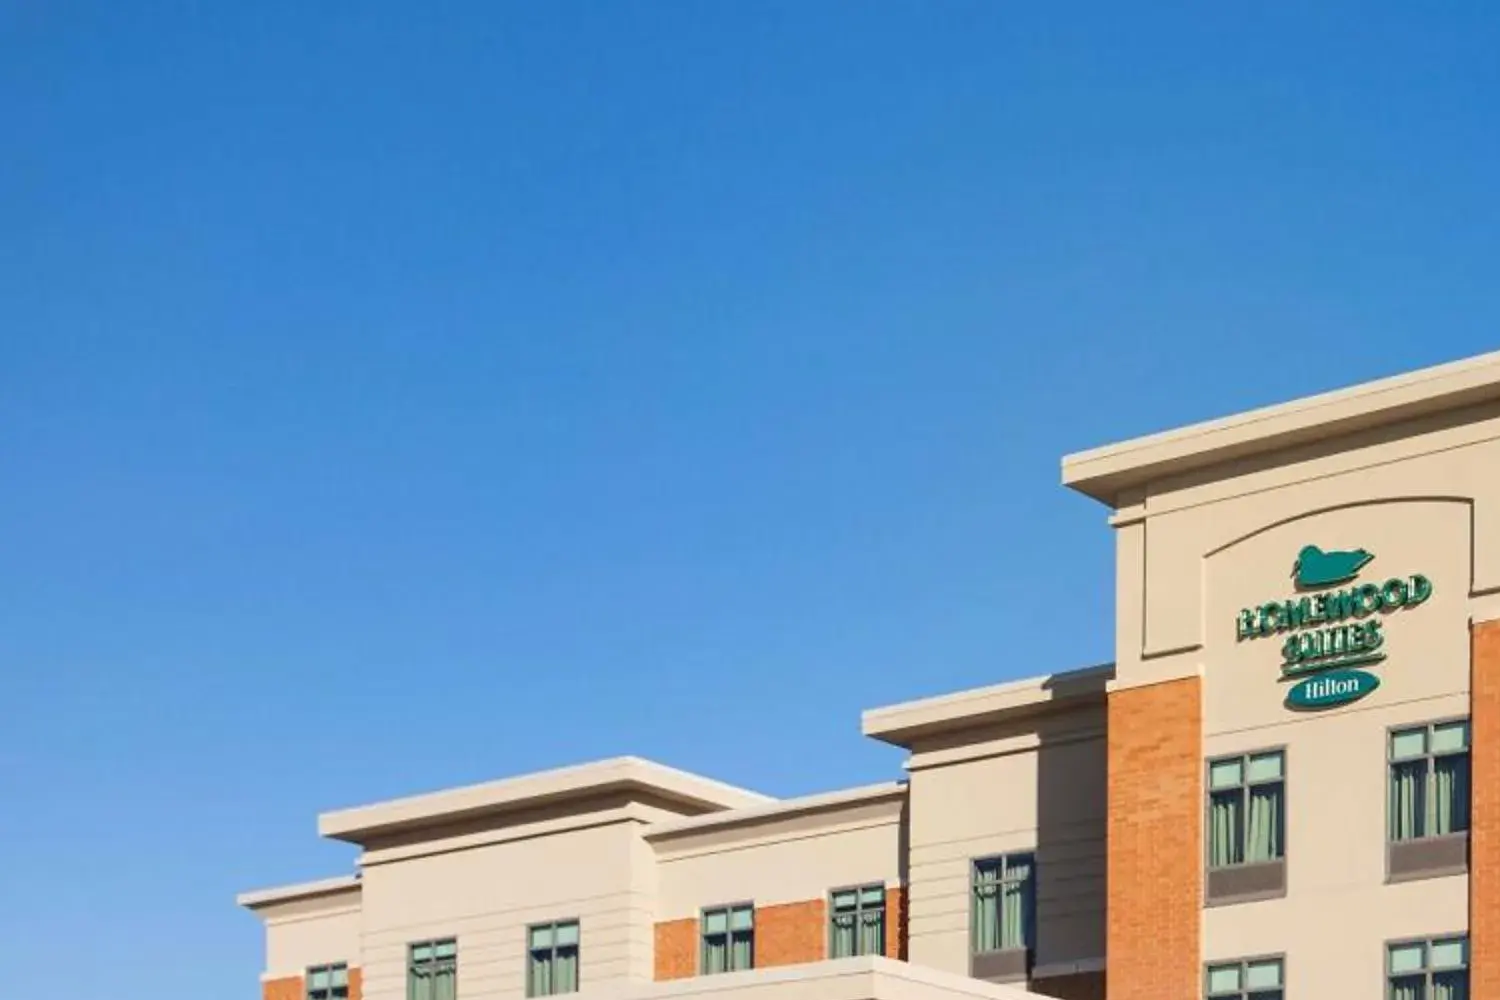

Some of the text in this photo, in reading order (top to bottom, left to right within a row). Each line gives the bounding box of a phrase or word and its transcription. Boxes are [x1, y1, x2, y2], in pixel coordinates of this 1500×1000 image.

[1237, 574, 1432, 640] HOMEWOOD
[1282, 619, 1384, 663] SUITES
[1305, 677, 1359, 699] Hilton
